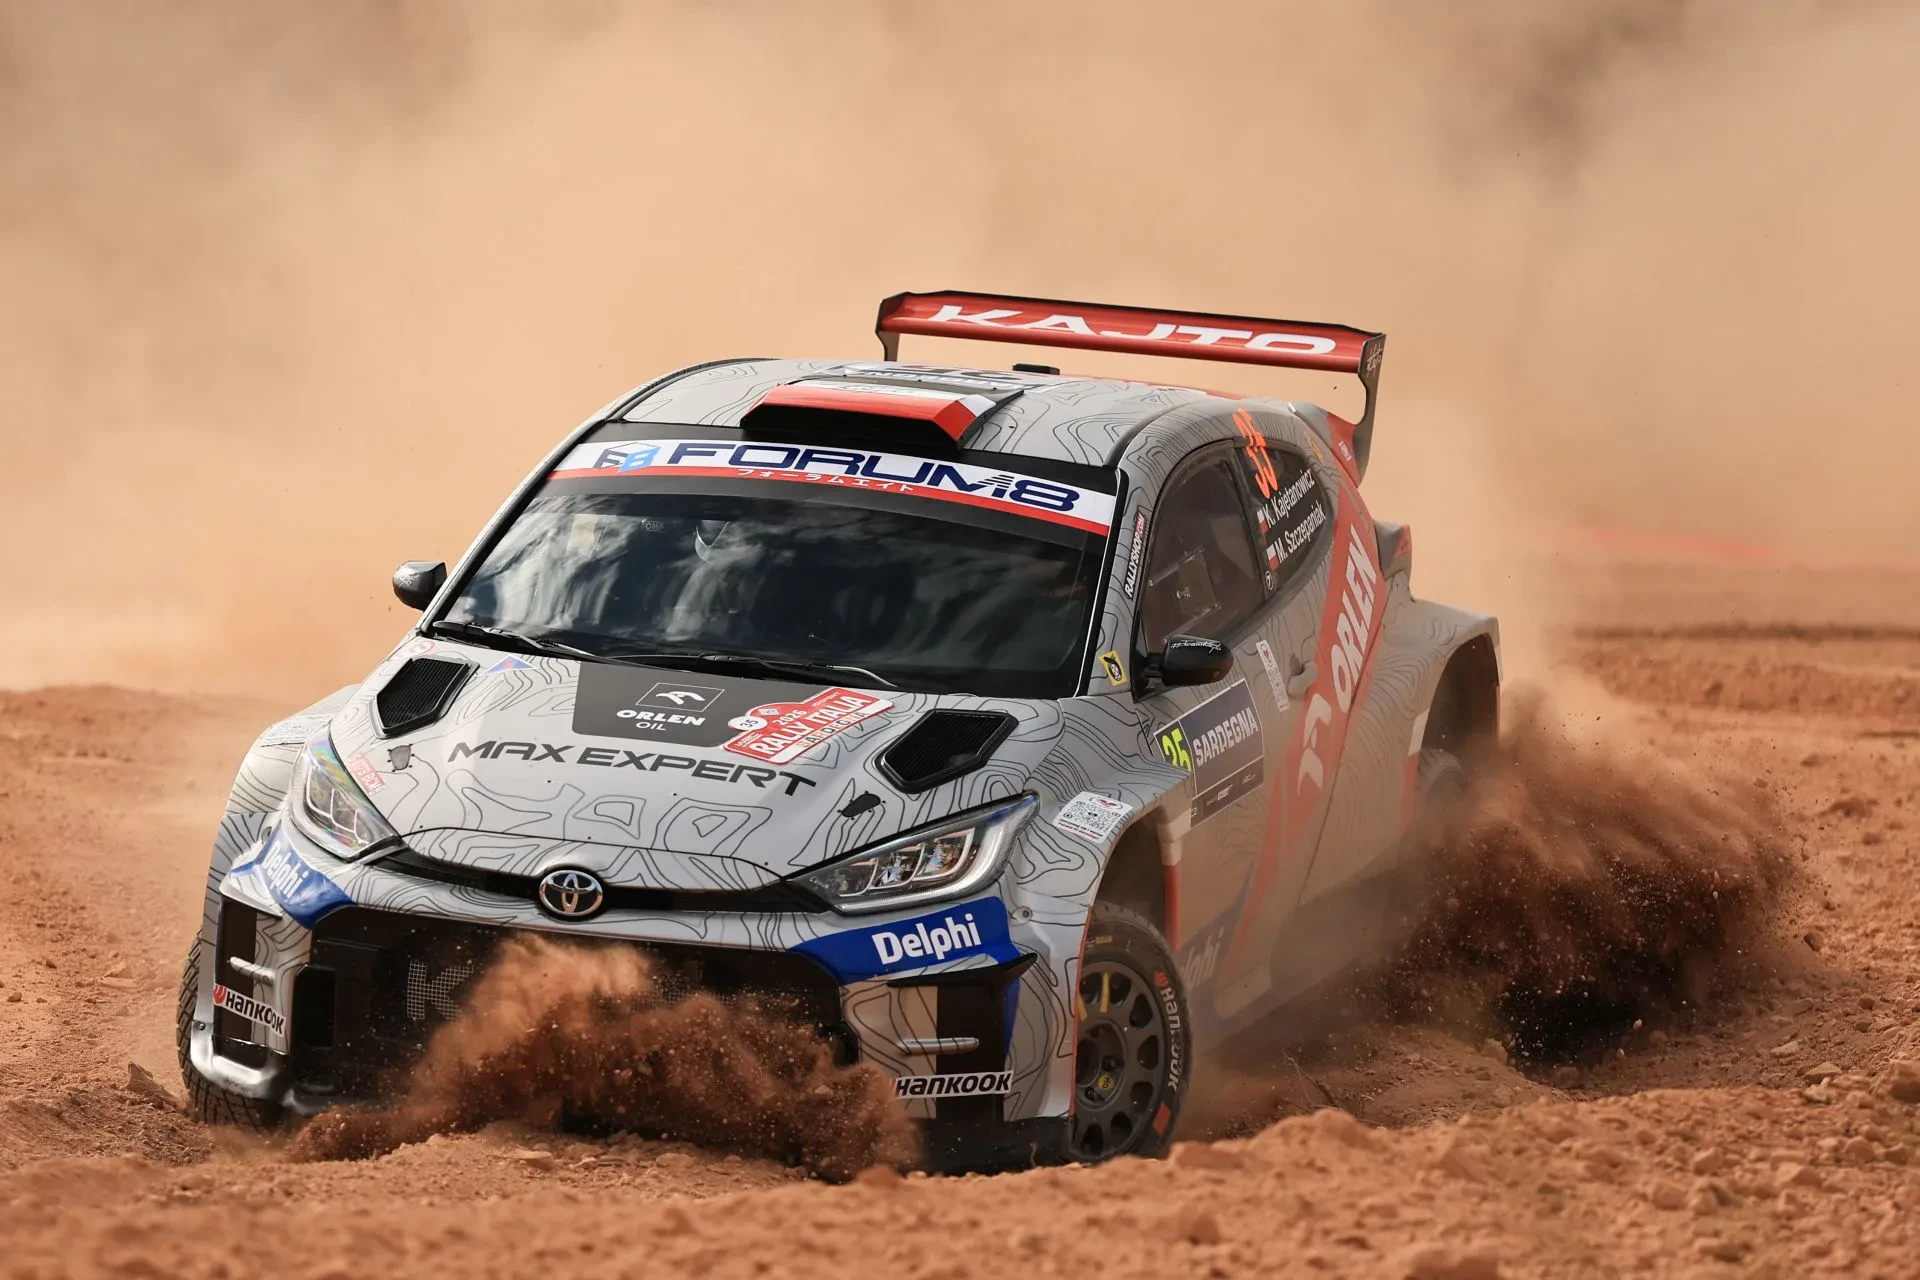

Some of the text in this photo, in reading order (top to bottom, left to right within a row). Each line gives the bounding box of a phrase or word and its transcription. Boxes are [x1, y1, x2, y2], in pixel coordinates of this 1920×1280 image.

[927, 305, 1336, 355] KAJTO
[667, 442, 1080, 511] FORUM8
[737, 468, 914, 492] フォーラムエイト
[1262, 467, 1316, 529] K. Kajetanowicz
[1272, 499, 1327, 564] M. Szczepaniak
[1331, 522, 1377, 713] ORLEN
[616, 709, 706, 726] ORLEN
[635, 721, 667, 732] OIL
[739, 719, 759, 728] 35
[750, 721, 814, 755] RALLY
[804, 695, 873, 725] ITALIA
[797, 711, 869, 749] SARDEGNA
[1192, 706, 1259, 767] SARDEGNA
[447, 741, 817, 796] MAX EXPERT
[262, 839, 309, 903] Delphi
[871, 913, 982, 966] Delphi
